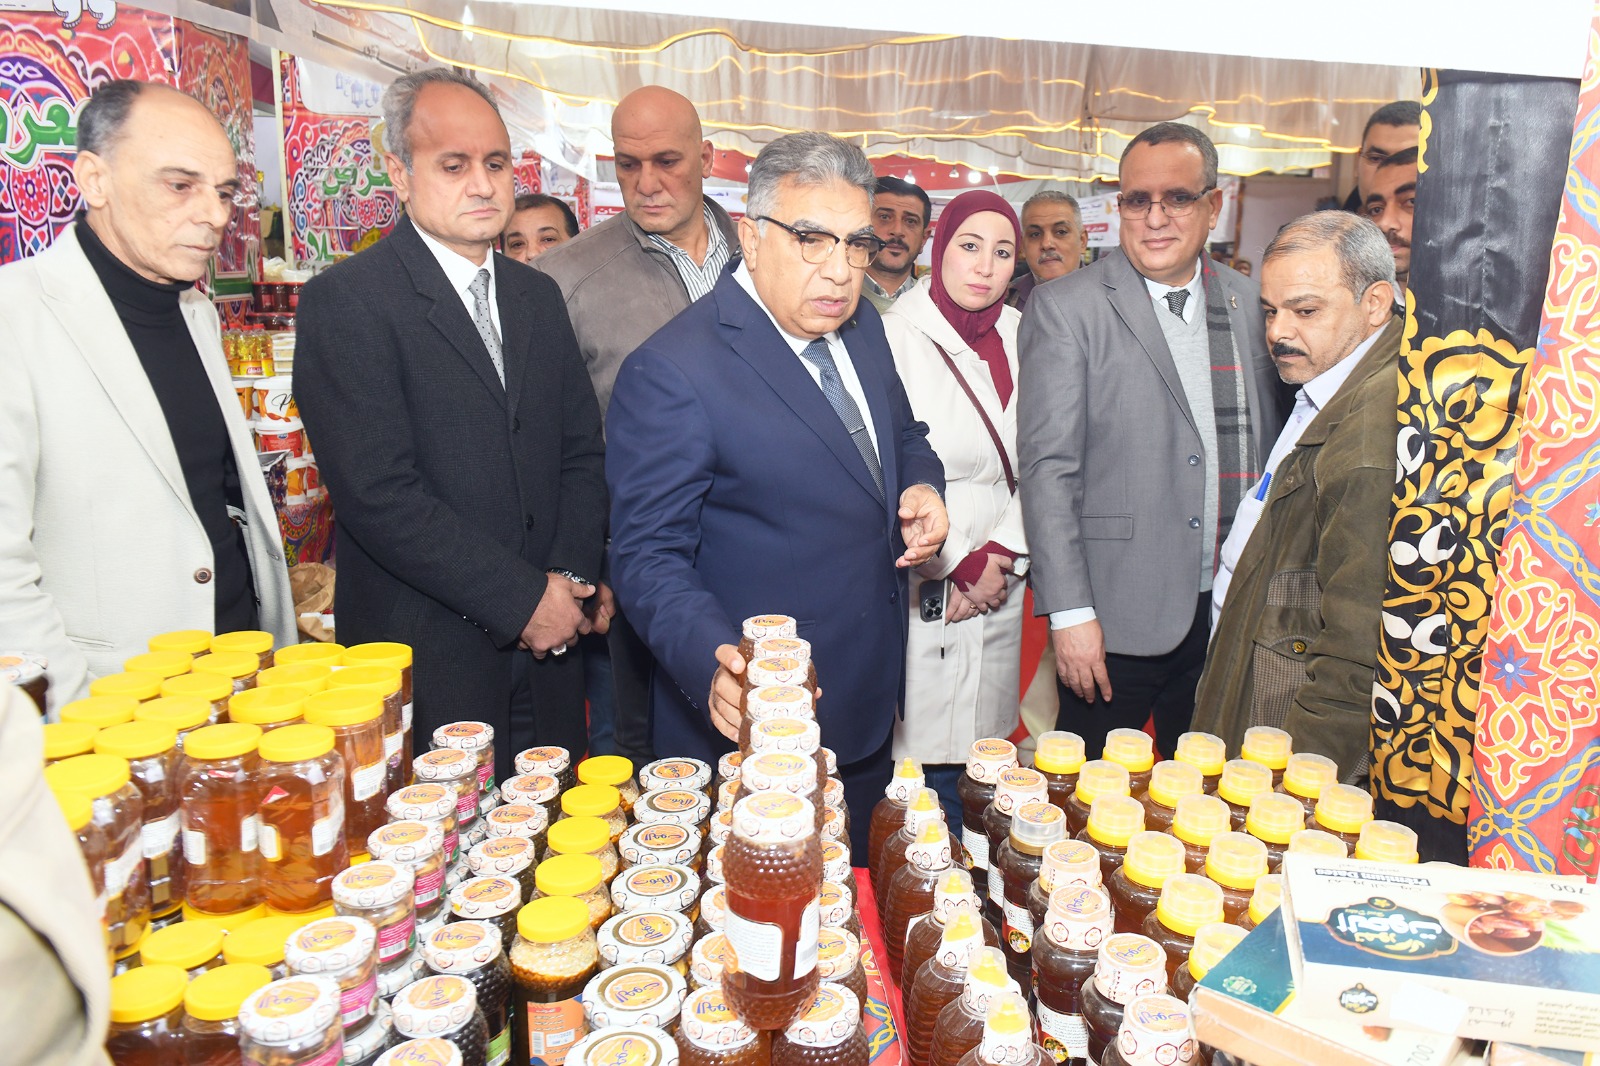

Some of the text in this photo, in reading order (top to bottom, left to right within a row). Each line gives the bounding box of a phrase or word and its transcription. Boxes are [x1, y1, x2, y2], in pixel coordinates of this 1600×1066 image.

[0, 103, 79, 166] عر
[1315, 868, 1360, 880] Dates
[1550, 883, 1591, 896] 700
[1336, 912, 1443, 940] الحوت
[1353, 931, 1398, 944] تمور
[696, 1001, 731, 1015] الحو
